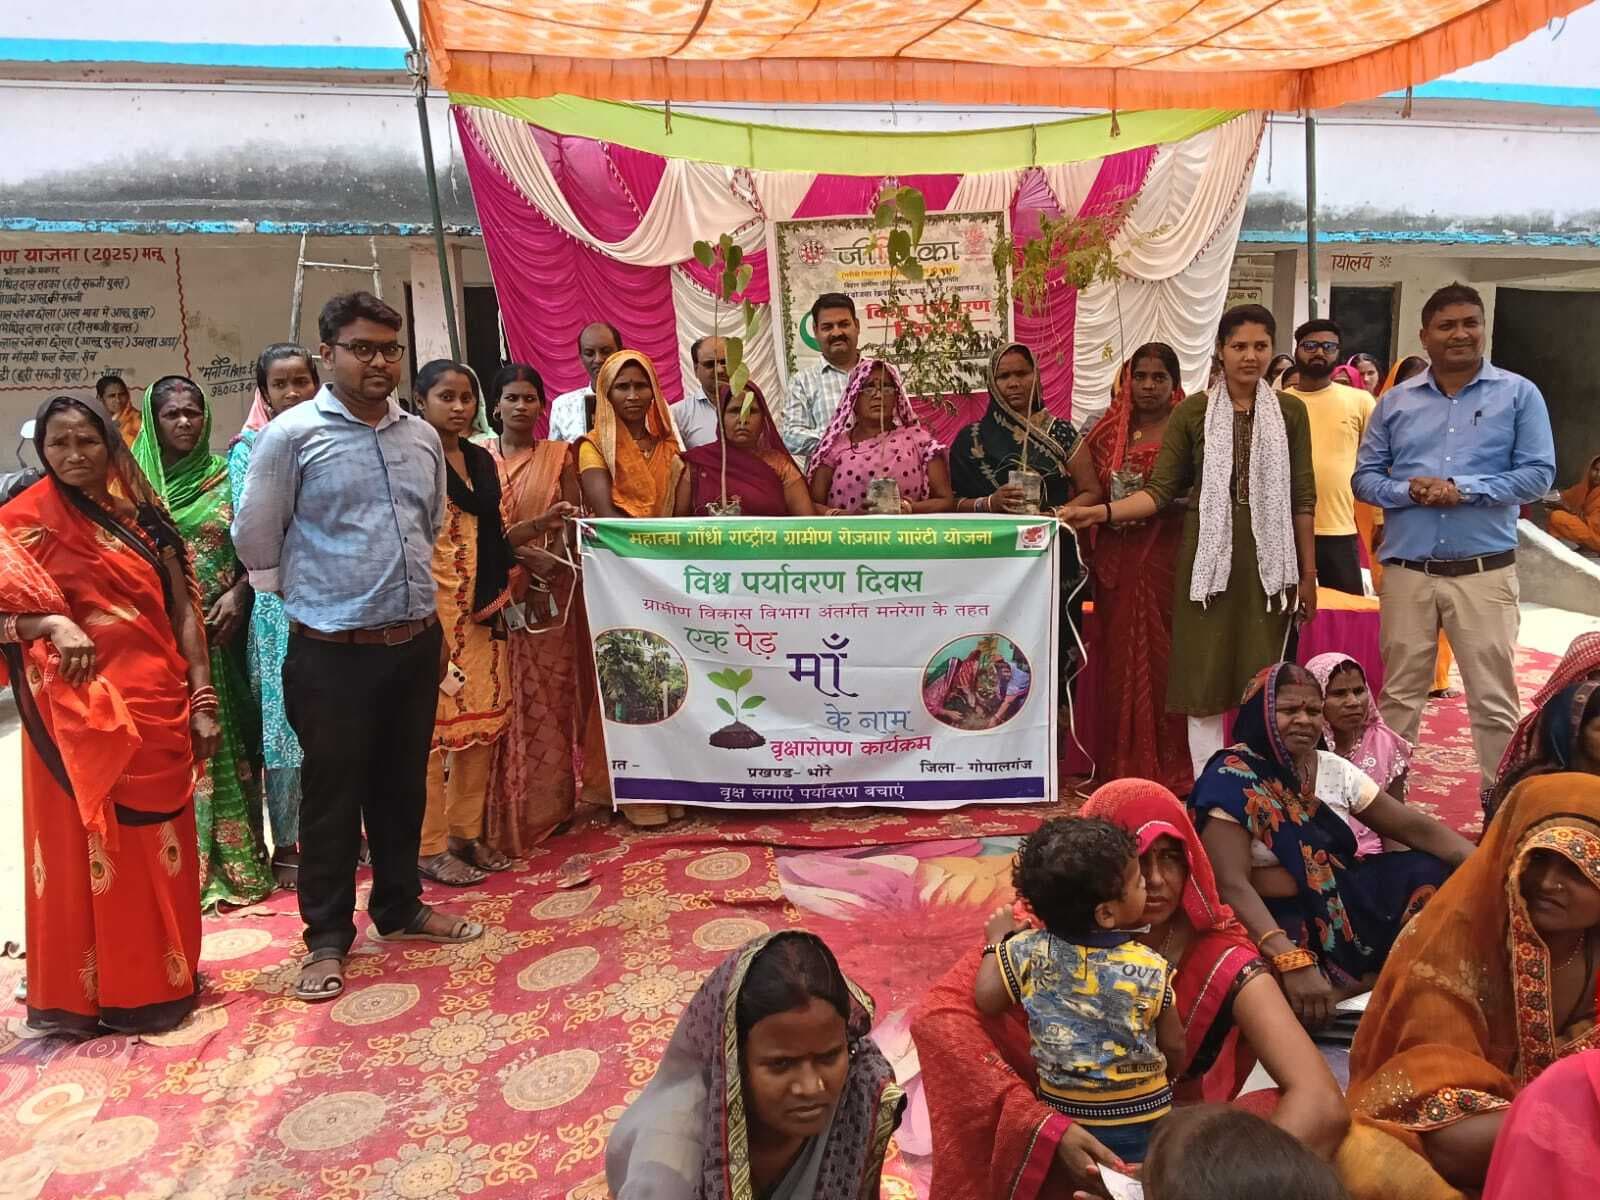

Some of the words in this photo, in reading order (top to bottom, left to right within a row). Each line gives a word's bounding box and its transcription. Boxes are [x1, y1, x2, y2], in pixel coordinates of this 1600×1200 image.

[84, 247, 138, 263] (2025)
[629, 530, 681, 546] महात्मा
[728, 527, 777, 548] राष्ट्रीय
[783, 527, 832, 546] ग्रामीण
[897, 527, 938, 546] गारंटी
[943, 527, 993, 546] योजना
[683, 564, 732, 595] विश्व
[741, 563, 847, 595] पर्यावरण
[856, 564, 924, 595] दिवस
[642, 598, 693, 619] ग्रामीण
[699, 604, 752, 621] विकास
[760, 603, 812, 620] विभाग
[818, 602, 870, 620] अंतर्गत
[876, 601, 927, 618] मनरेगा
[932, 600, 949, 617] के
[954, 603, 992, 618] तहत
[683, 626, 729, 655] एक
[733, 623, 779, 662] पेड़
[785, 632, 860, 699] माँ
[823, 702, 851, 734] के
[858, 709, 915, 735] नाम
[769, 736, 854, 762] वृक्षारोपण
[858, 735, 933, 757] कार्यक्रम
[807, 764, 833, 778] भोरे
[967, 758, 1033, 774] गोपालगंज
[719, 785, 745, 802] वृक्ष
[752, 785, 794, 802] लगाएं
[799, 785, 859, 801] पर्यावरण
[863, 784, 905, 801] बचाएं
